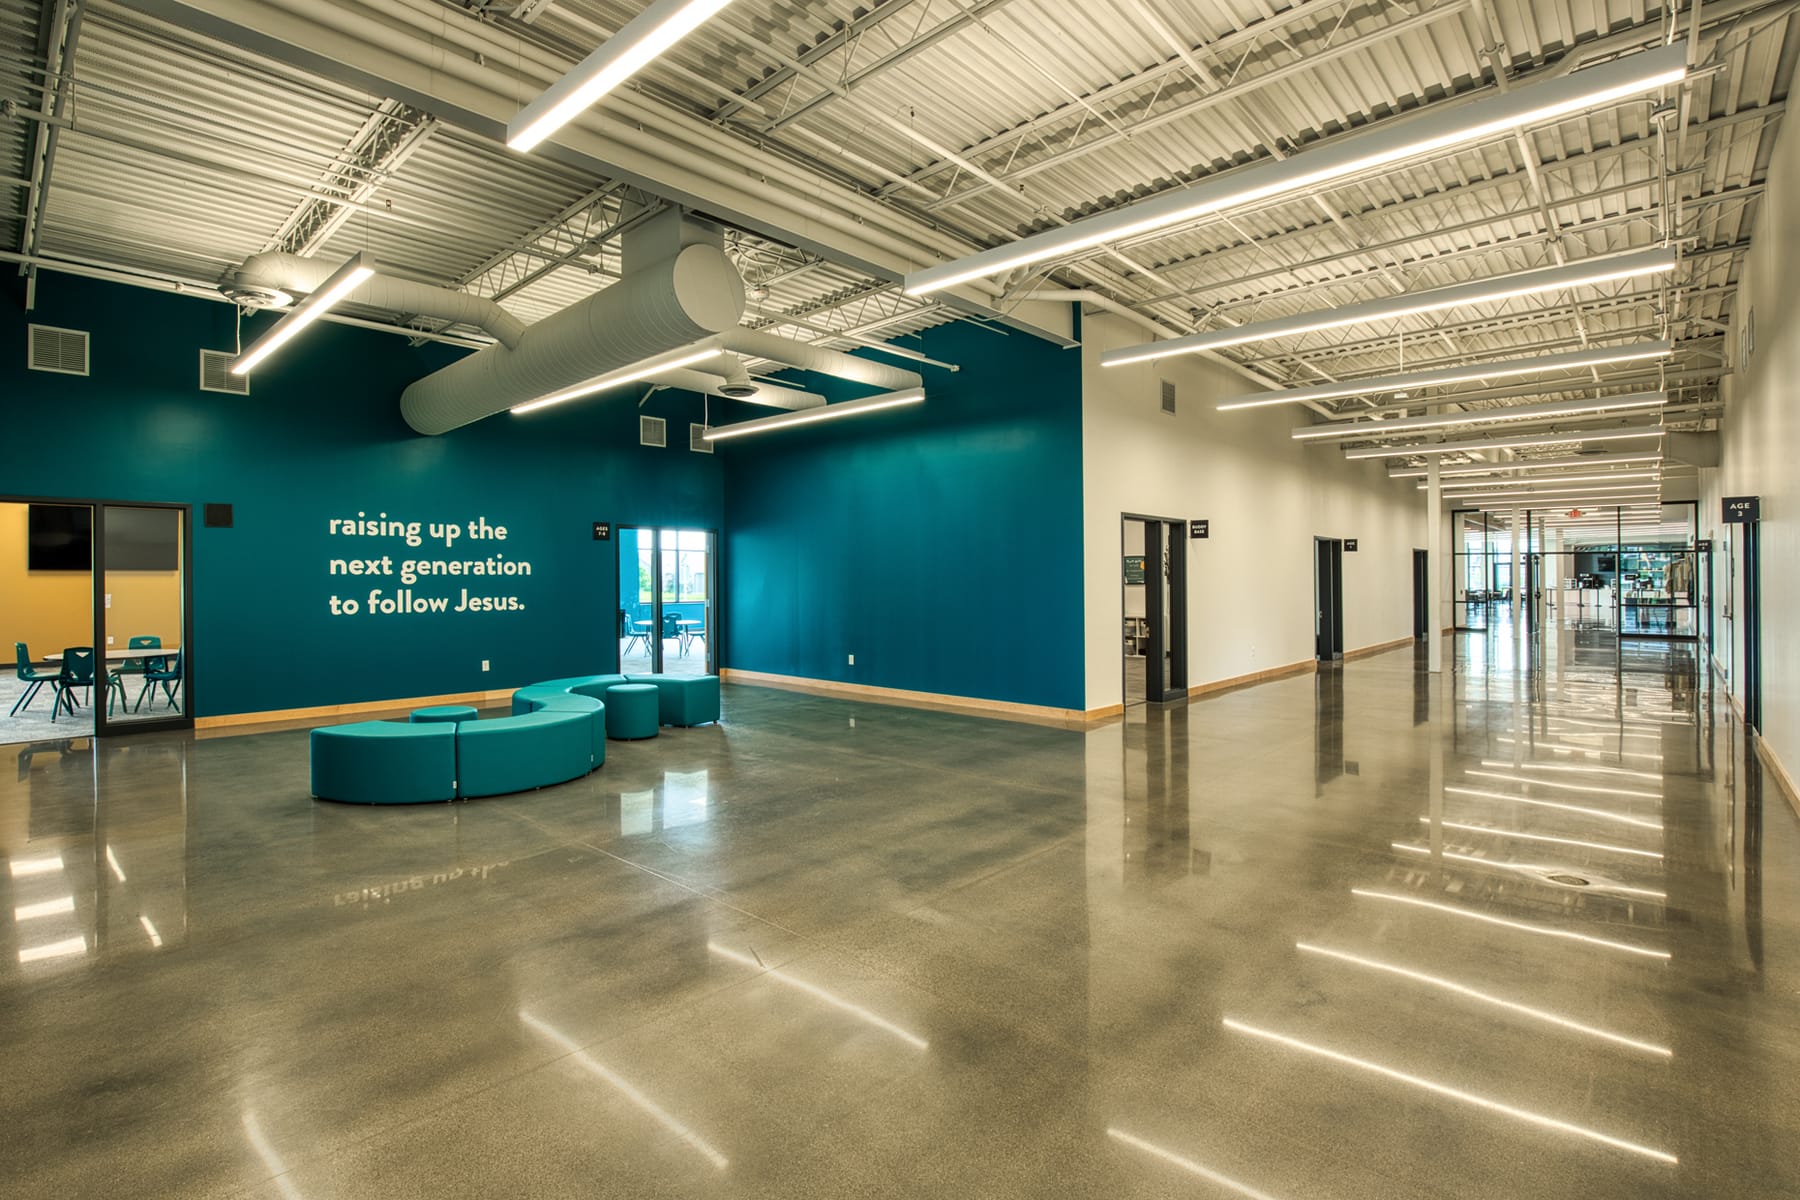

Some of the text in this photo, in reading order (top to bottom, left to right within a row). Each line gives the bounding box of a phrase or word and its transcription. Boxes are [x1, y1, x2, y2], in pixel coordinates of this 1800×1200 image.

[1729, 502, 1751, 510] AGE
[329, 512, 508, 547] raising up the
[329, 554, 531, 585] next generation
[329, 588, 525, 615] to follow Jesus.
